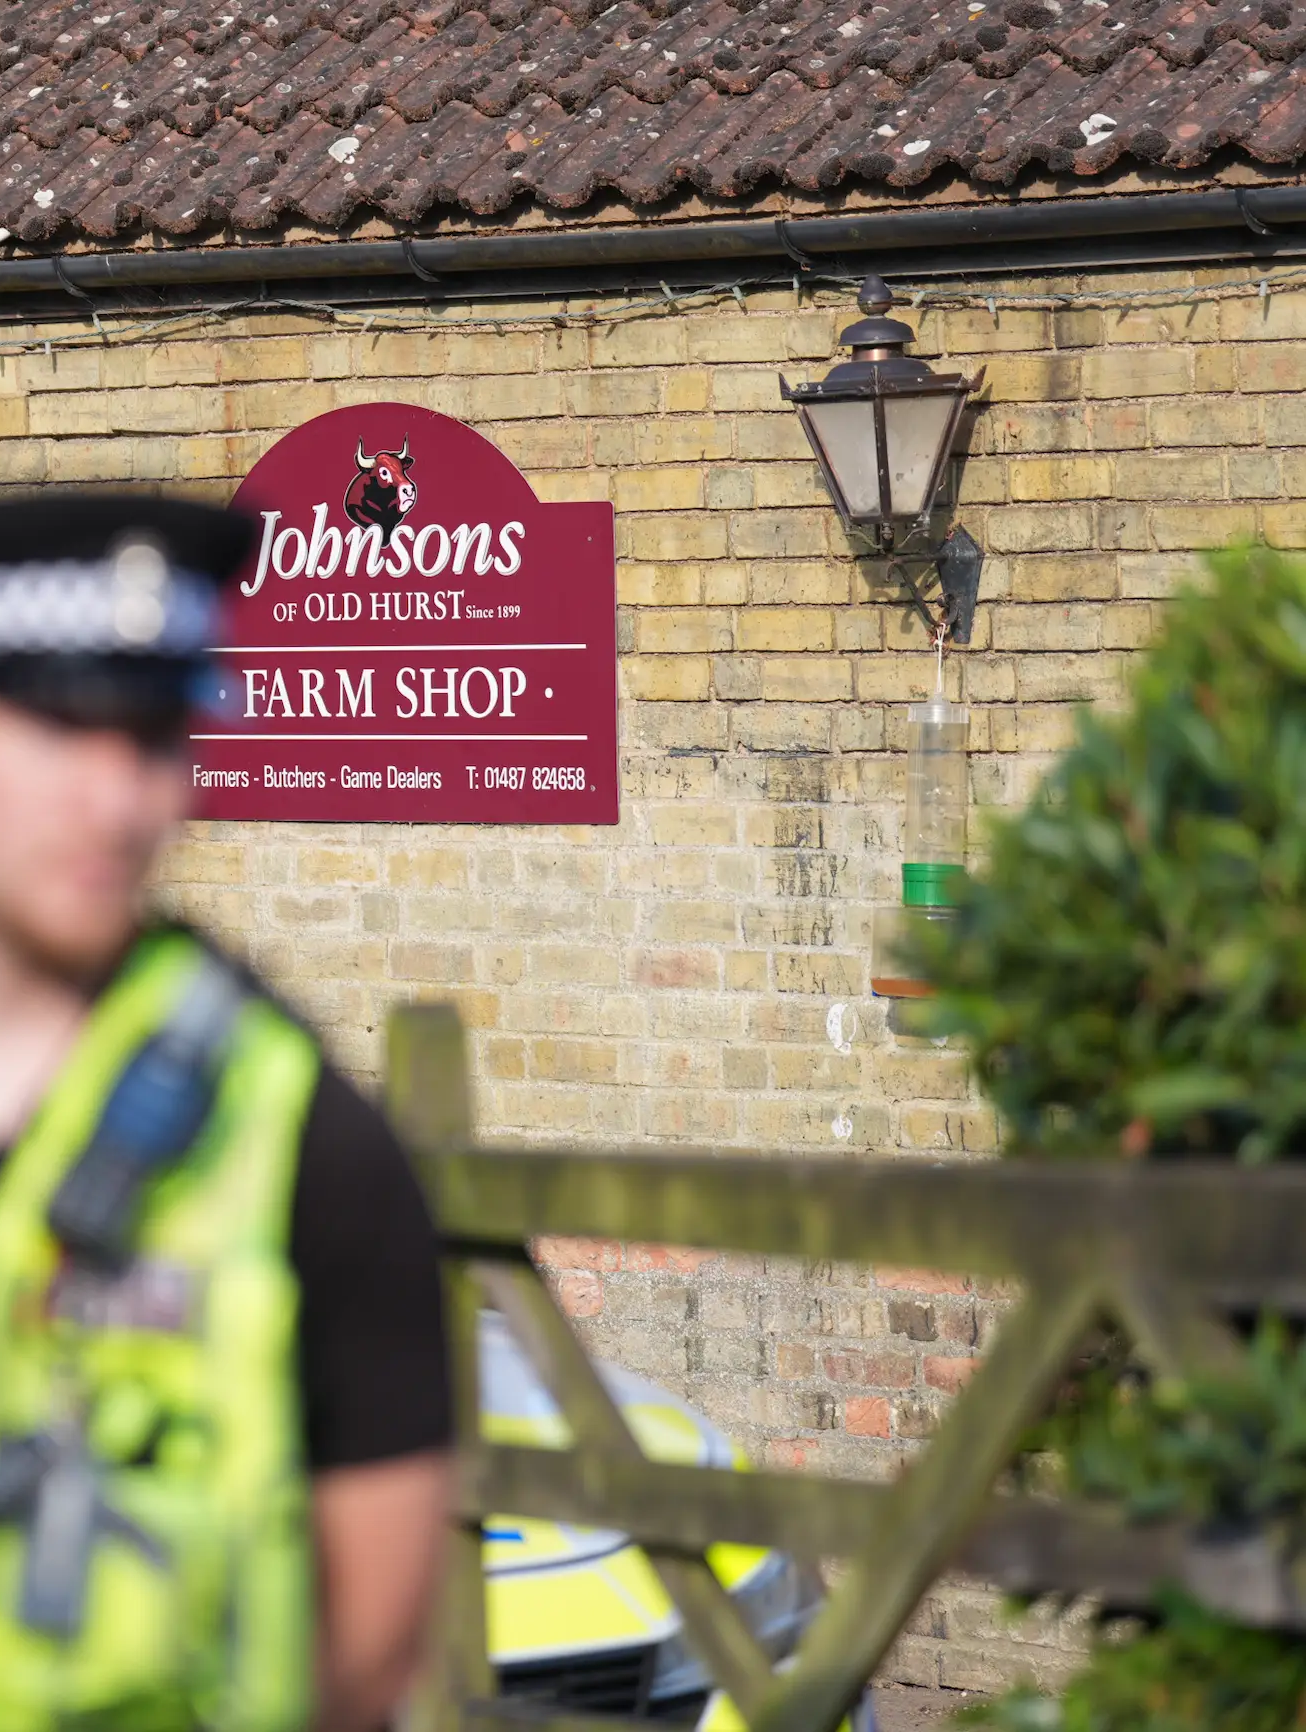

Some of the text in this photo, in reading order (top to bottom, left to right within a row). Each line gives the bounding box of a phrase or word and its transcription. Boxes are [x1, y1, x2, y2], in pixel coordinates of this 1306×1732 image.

[240, 502, 526, 598] Johnsons
[272, 590, 521, 622] OF OLD HURST Since 1899
[242, 666, 527, 719] FARM SHOP
[192, 764, 250, 788] Farmers
[263, 764, 326, 789] Butchers
[340, 764, 383, 789] Game
[386, 765, 443, 790] Dealers
[465, 766, 586, 791] T: 01487 824658
